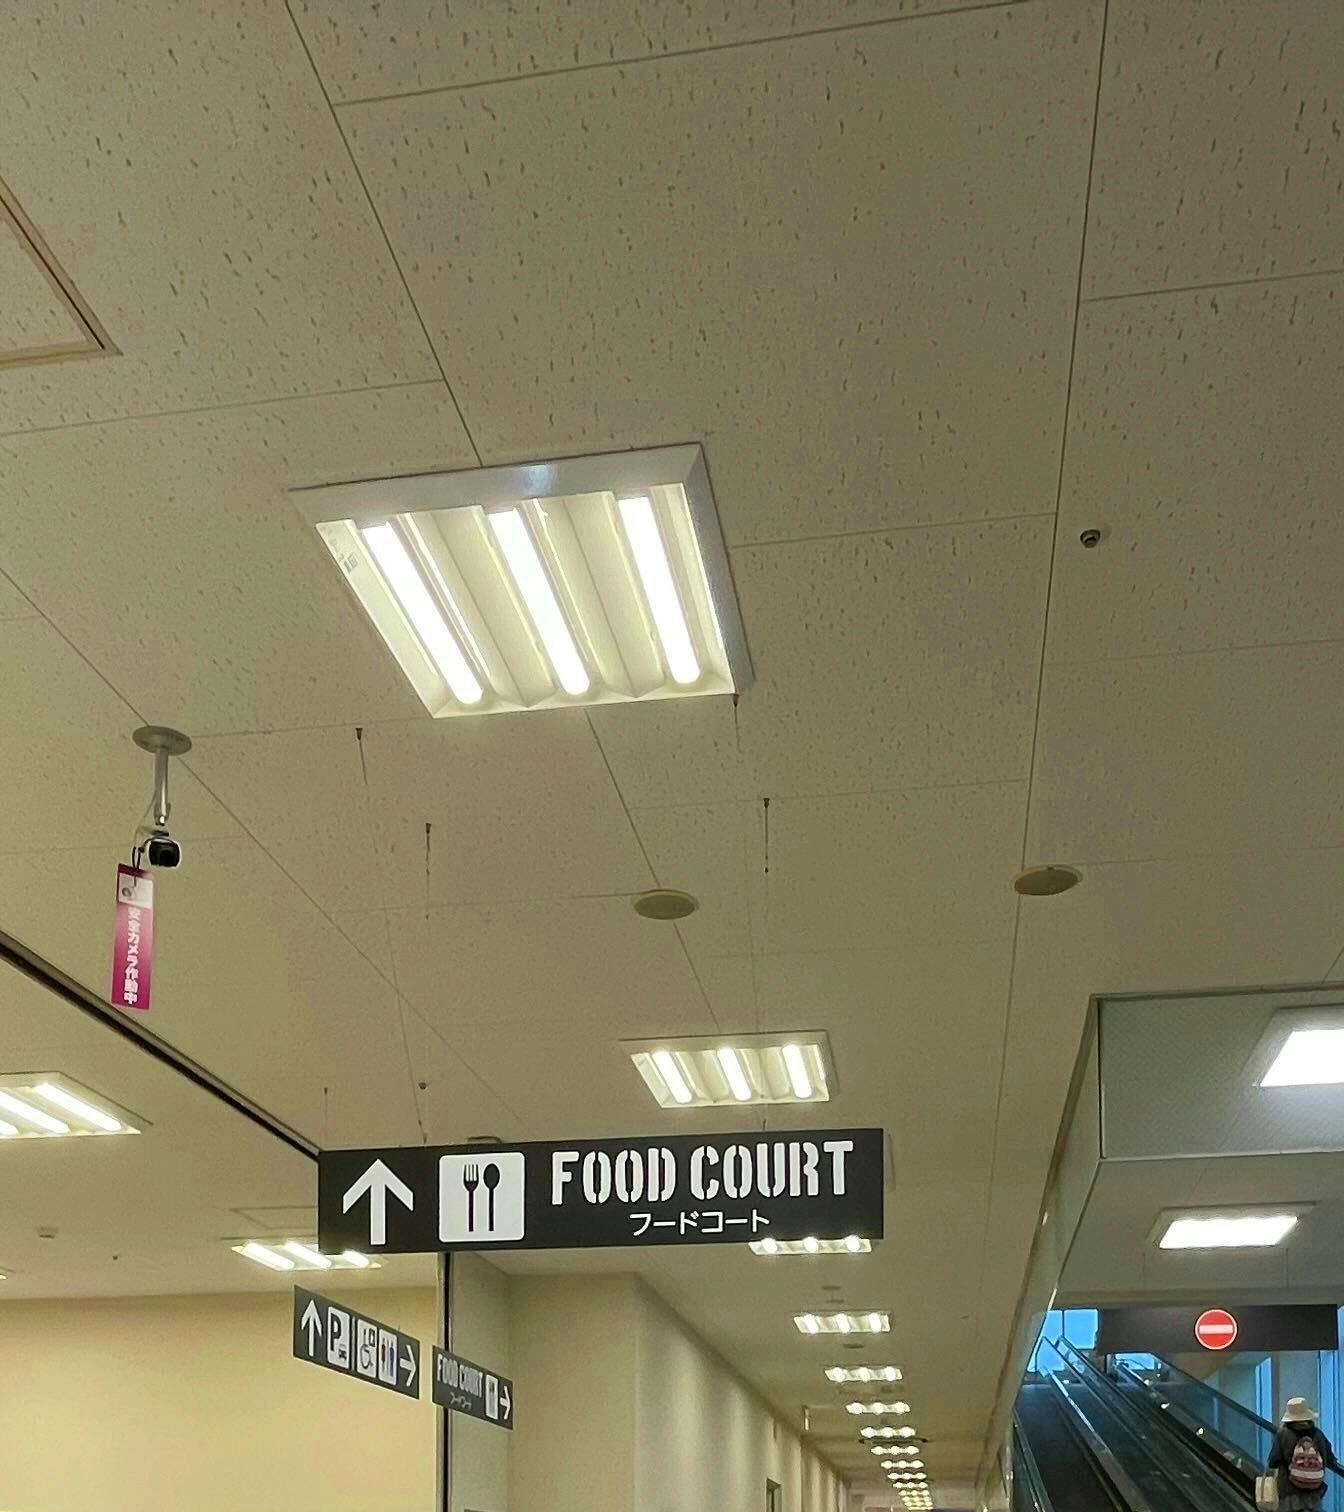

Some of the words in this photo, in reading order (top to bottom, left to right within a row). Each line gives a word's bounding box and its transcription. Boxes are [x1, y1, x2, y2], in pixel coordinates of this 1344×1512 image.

[552, 1147, 676, 1205] FOOD
[690, 1140, 853, 1200] COURT
[629, 1210, 770, 1236] フードコート
